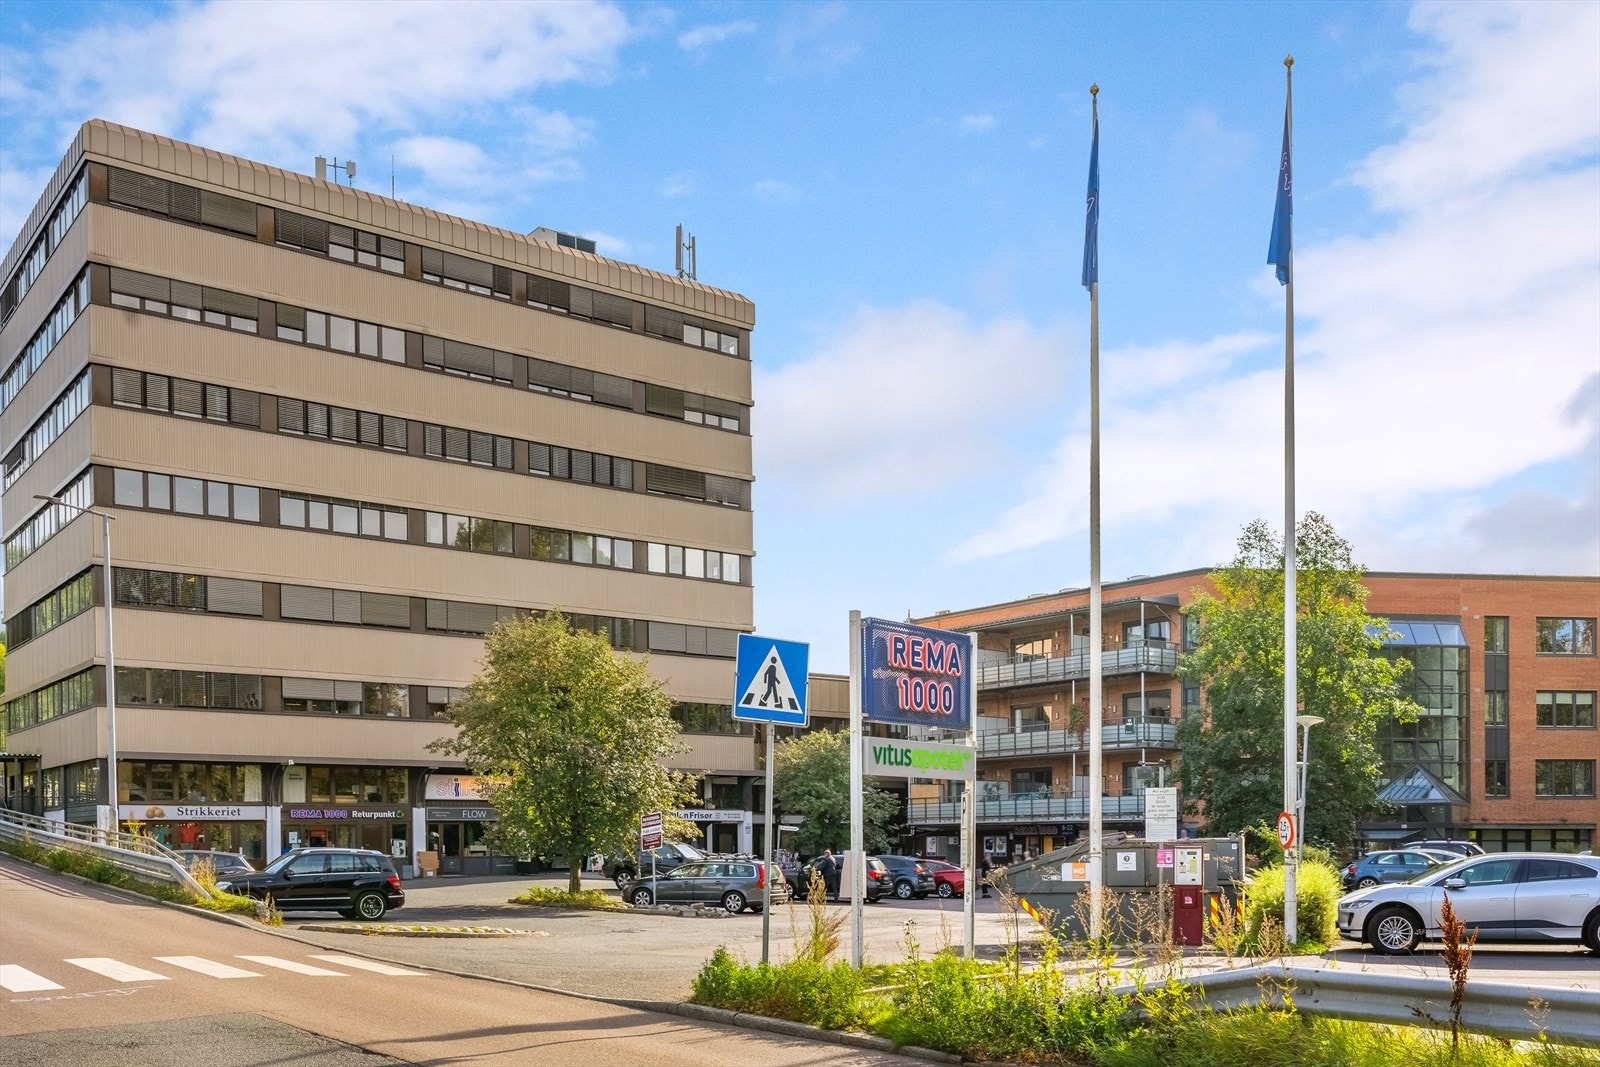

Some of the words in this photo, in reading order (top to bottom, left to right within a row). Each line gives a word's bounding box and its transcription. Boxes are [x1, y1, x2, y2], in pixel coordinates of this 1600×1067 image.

[888, 633, 961, 676] REMA
[897, 675, 954, 714] 1000
[177, 806, 241, 817] Strikkeriet
[291, 809, 323, 819] REMA
[324, 809, 348, 819] 1000
[352, 810, 396, 820] Returpunkt
[462, 810, 487, 818] FLOW
[1014, 825, 1038, 835] REMA
[1039, 825, 1058, 835] 1000
